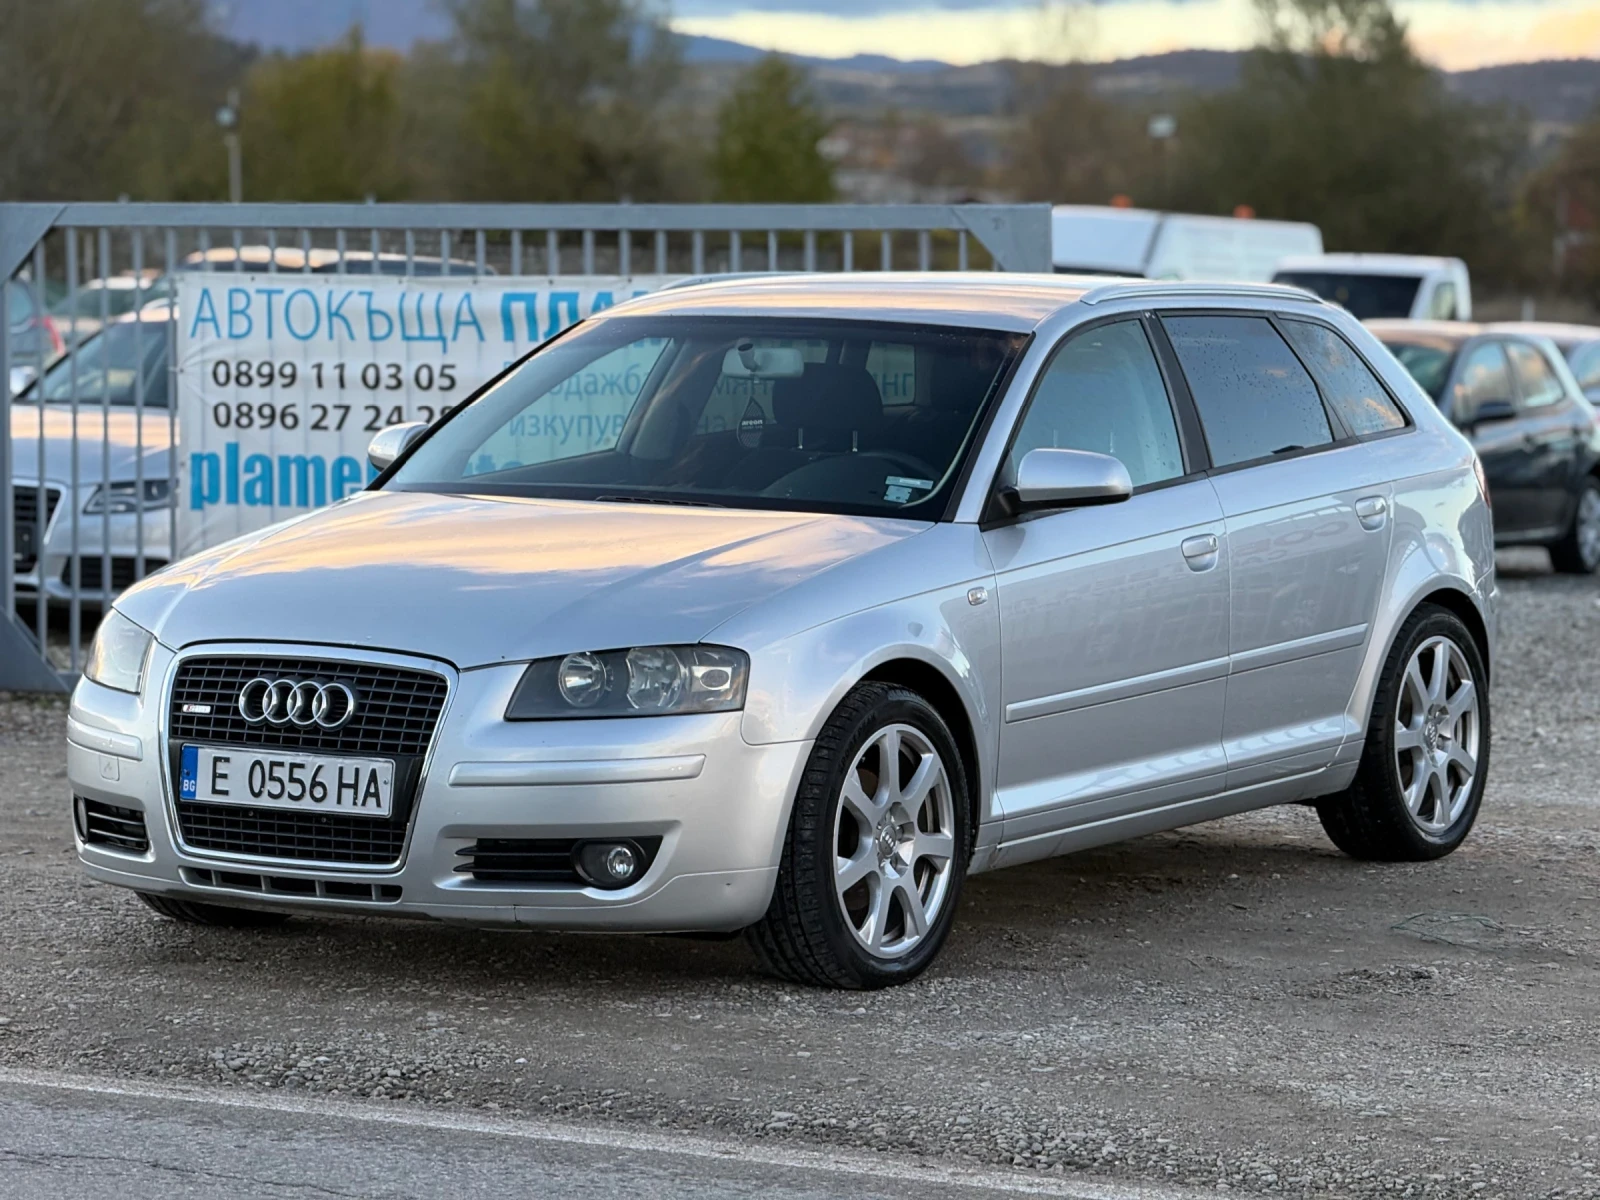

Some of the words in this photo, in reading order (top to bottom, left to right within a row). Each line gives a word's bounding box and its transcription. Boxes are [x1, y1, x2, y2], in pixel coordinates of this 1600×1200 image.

[190, 287, 486, 354] АВТОКЪЩА
[212, 360, 297, 388] 0899
[311, 362, 346, 389] 11
[361, 363, 403, 391] 03
[414, 363, 457, 391] 05
[213, 402, 299, 429] 0896
[311, 404, 351, 431] 27
[363, 405, 405, 431] 24
[183, 779, 196, 792] BG
[211, 756, 231, 796] E
[248, 759, 328, 803] 0556
[336, 765, 382, 808] HA
